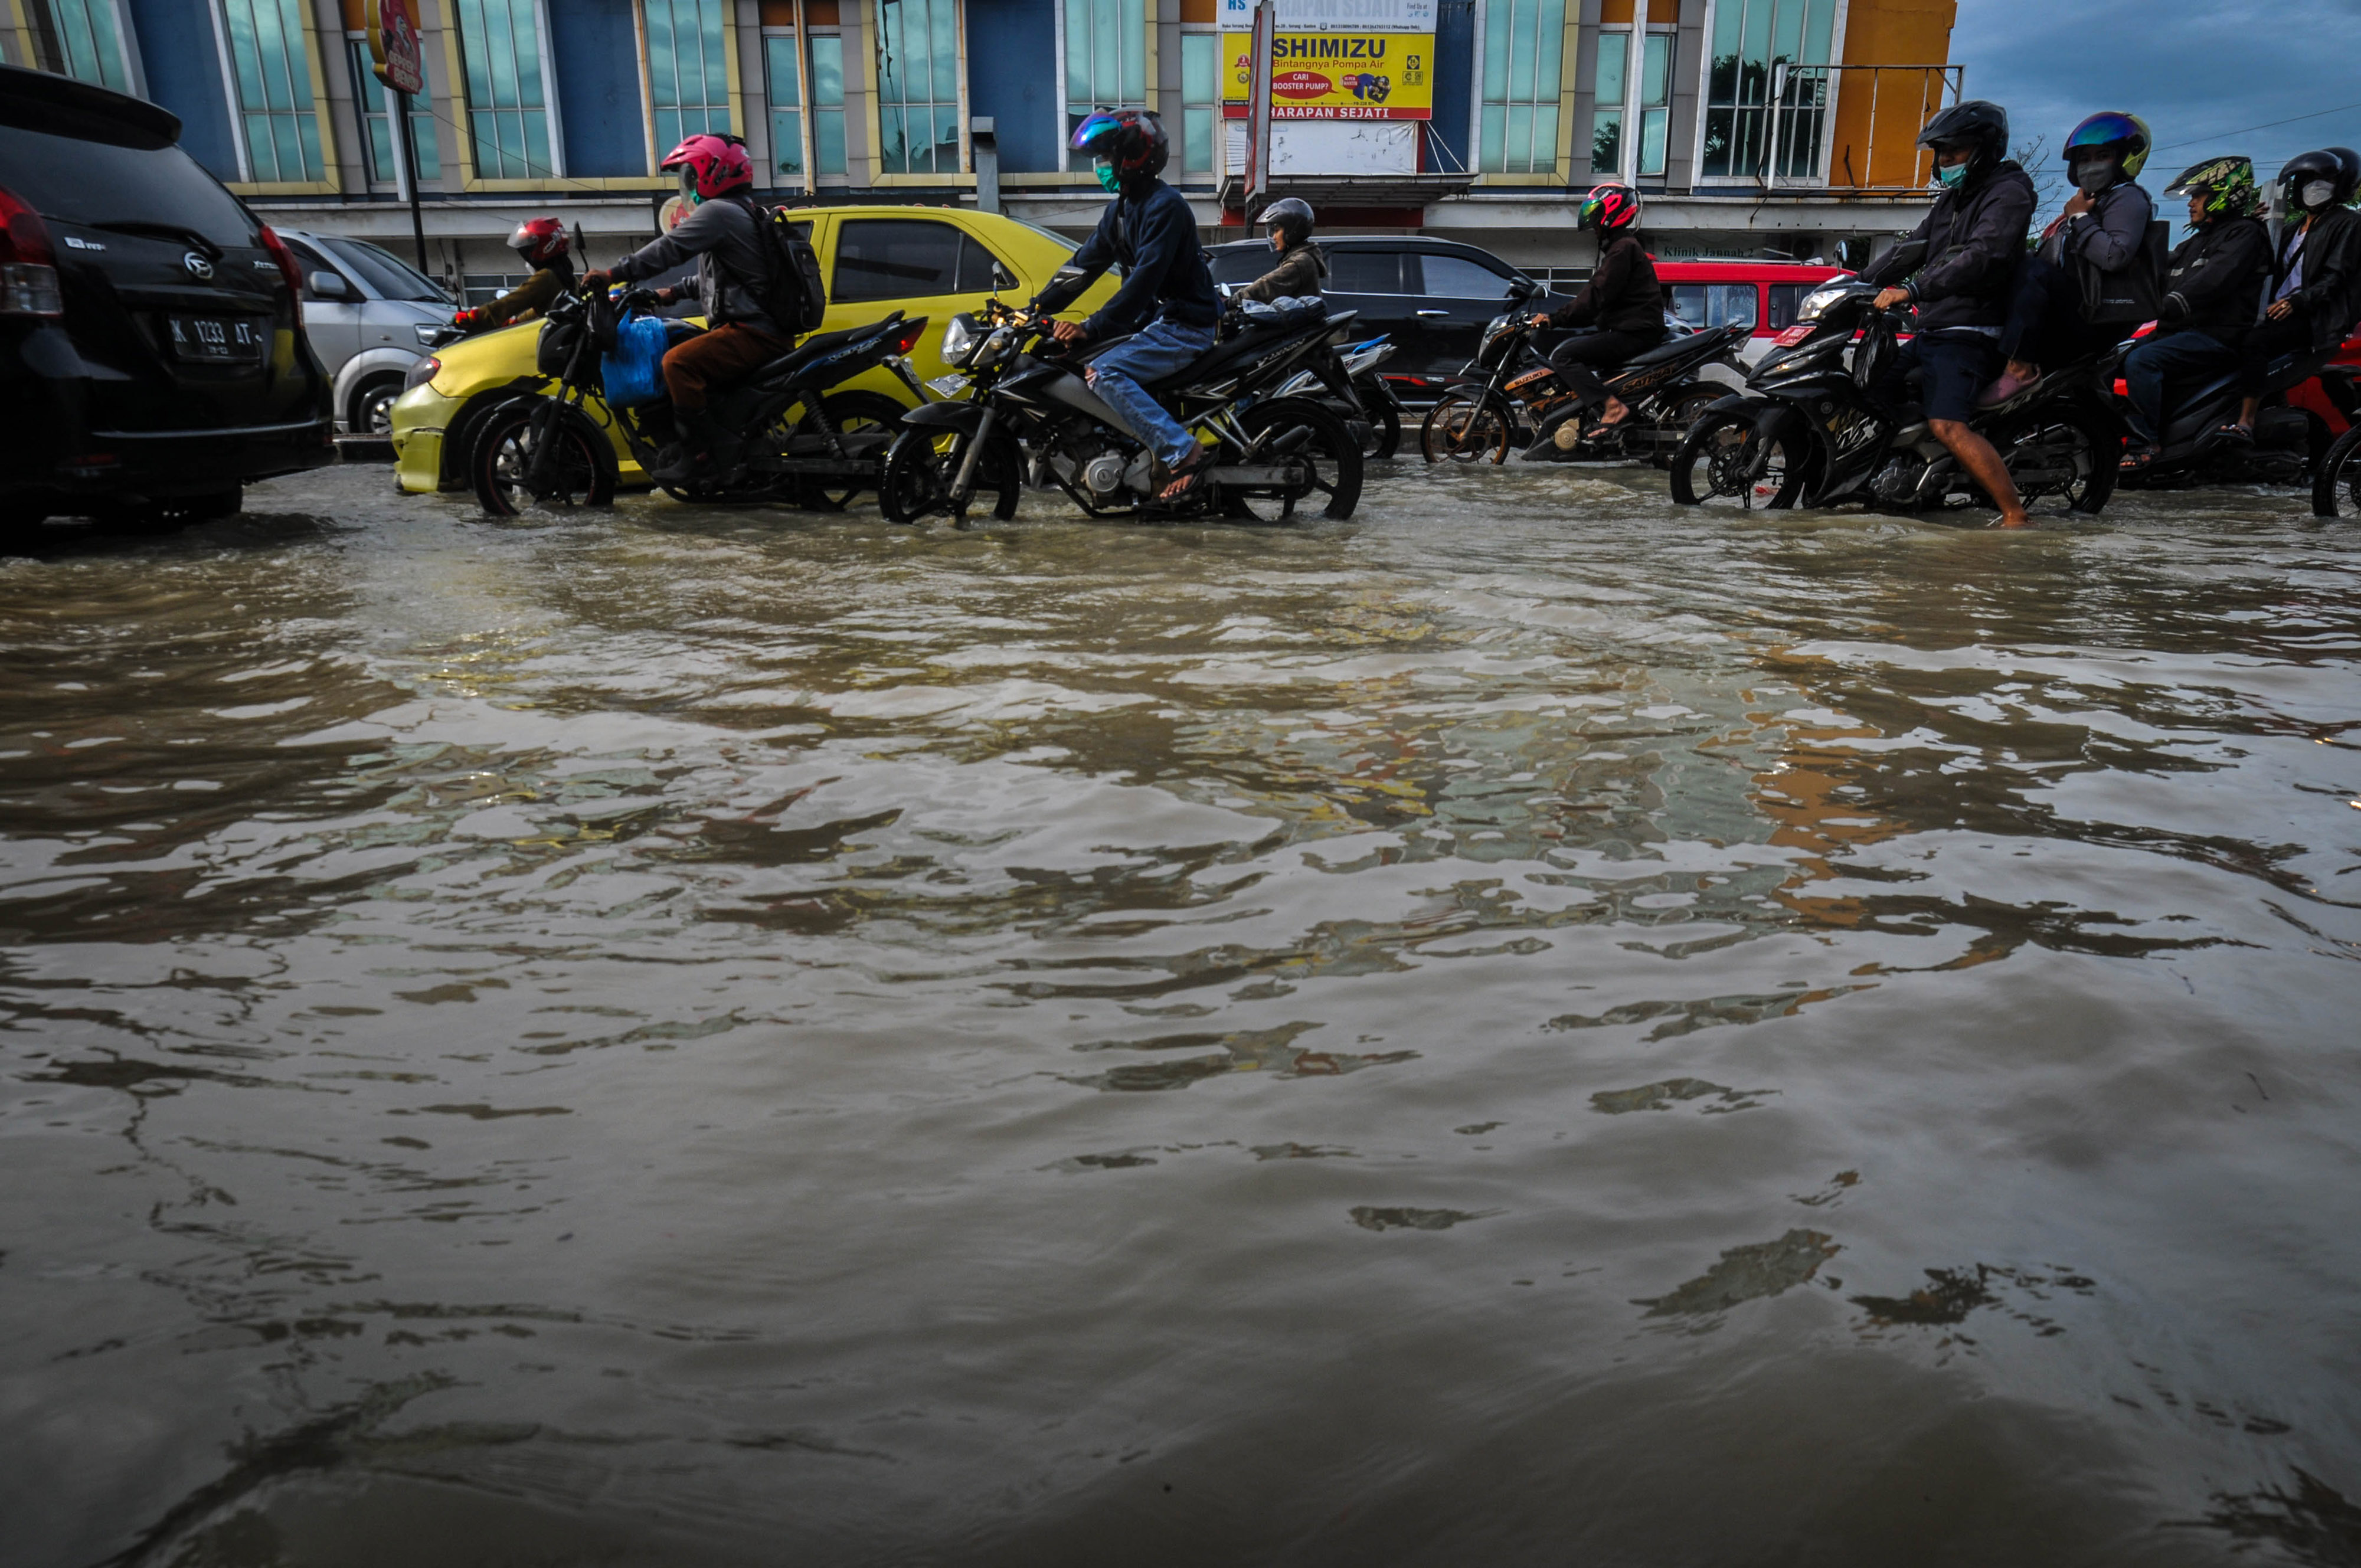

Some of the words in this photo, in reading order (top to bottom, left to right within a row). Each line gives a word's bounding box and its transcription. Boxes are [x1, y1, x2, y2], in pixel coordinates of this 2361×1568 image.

[1273, 38, 1385, 58] SHIMIZU
[1273, 60, 1329, 70] Bintangnya
[1333, 60, 1366, 70] Pompa
[1369, 60, 1384, 68] Air
[1340, 108, 1389, 118] SEJATI
[1664, 247, 1699, 257] Klinik
[1702, 247, 1744, 257] Jannah
[1748, 248, 1754, 257] 2
[1514, 371, 1543, 386] SUZUKI
